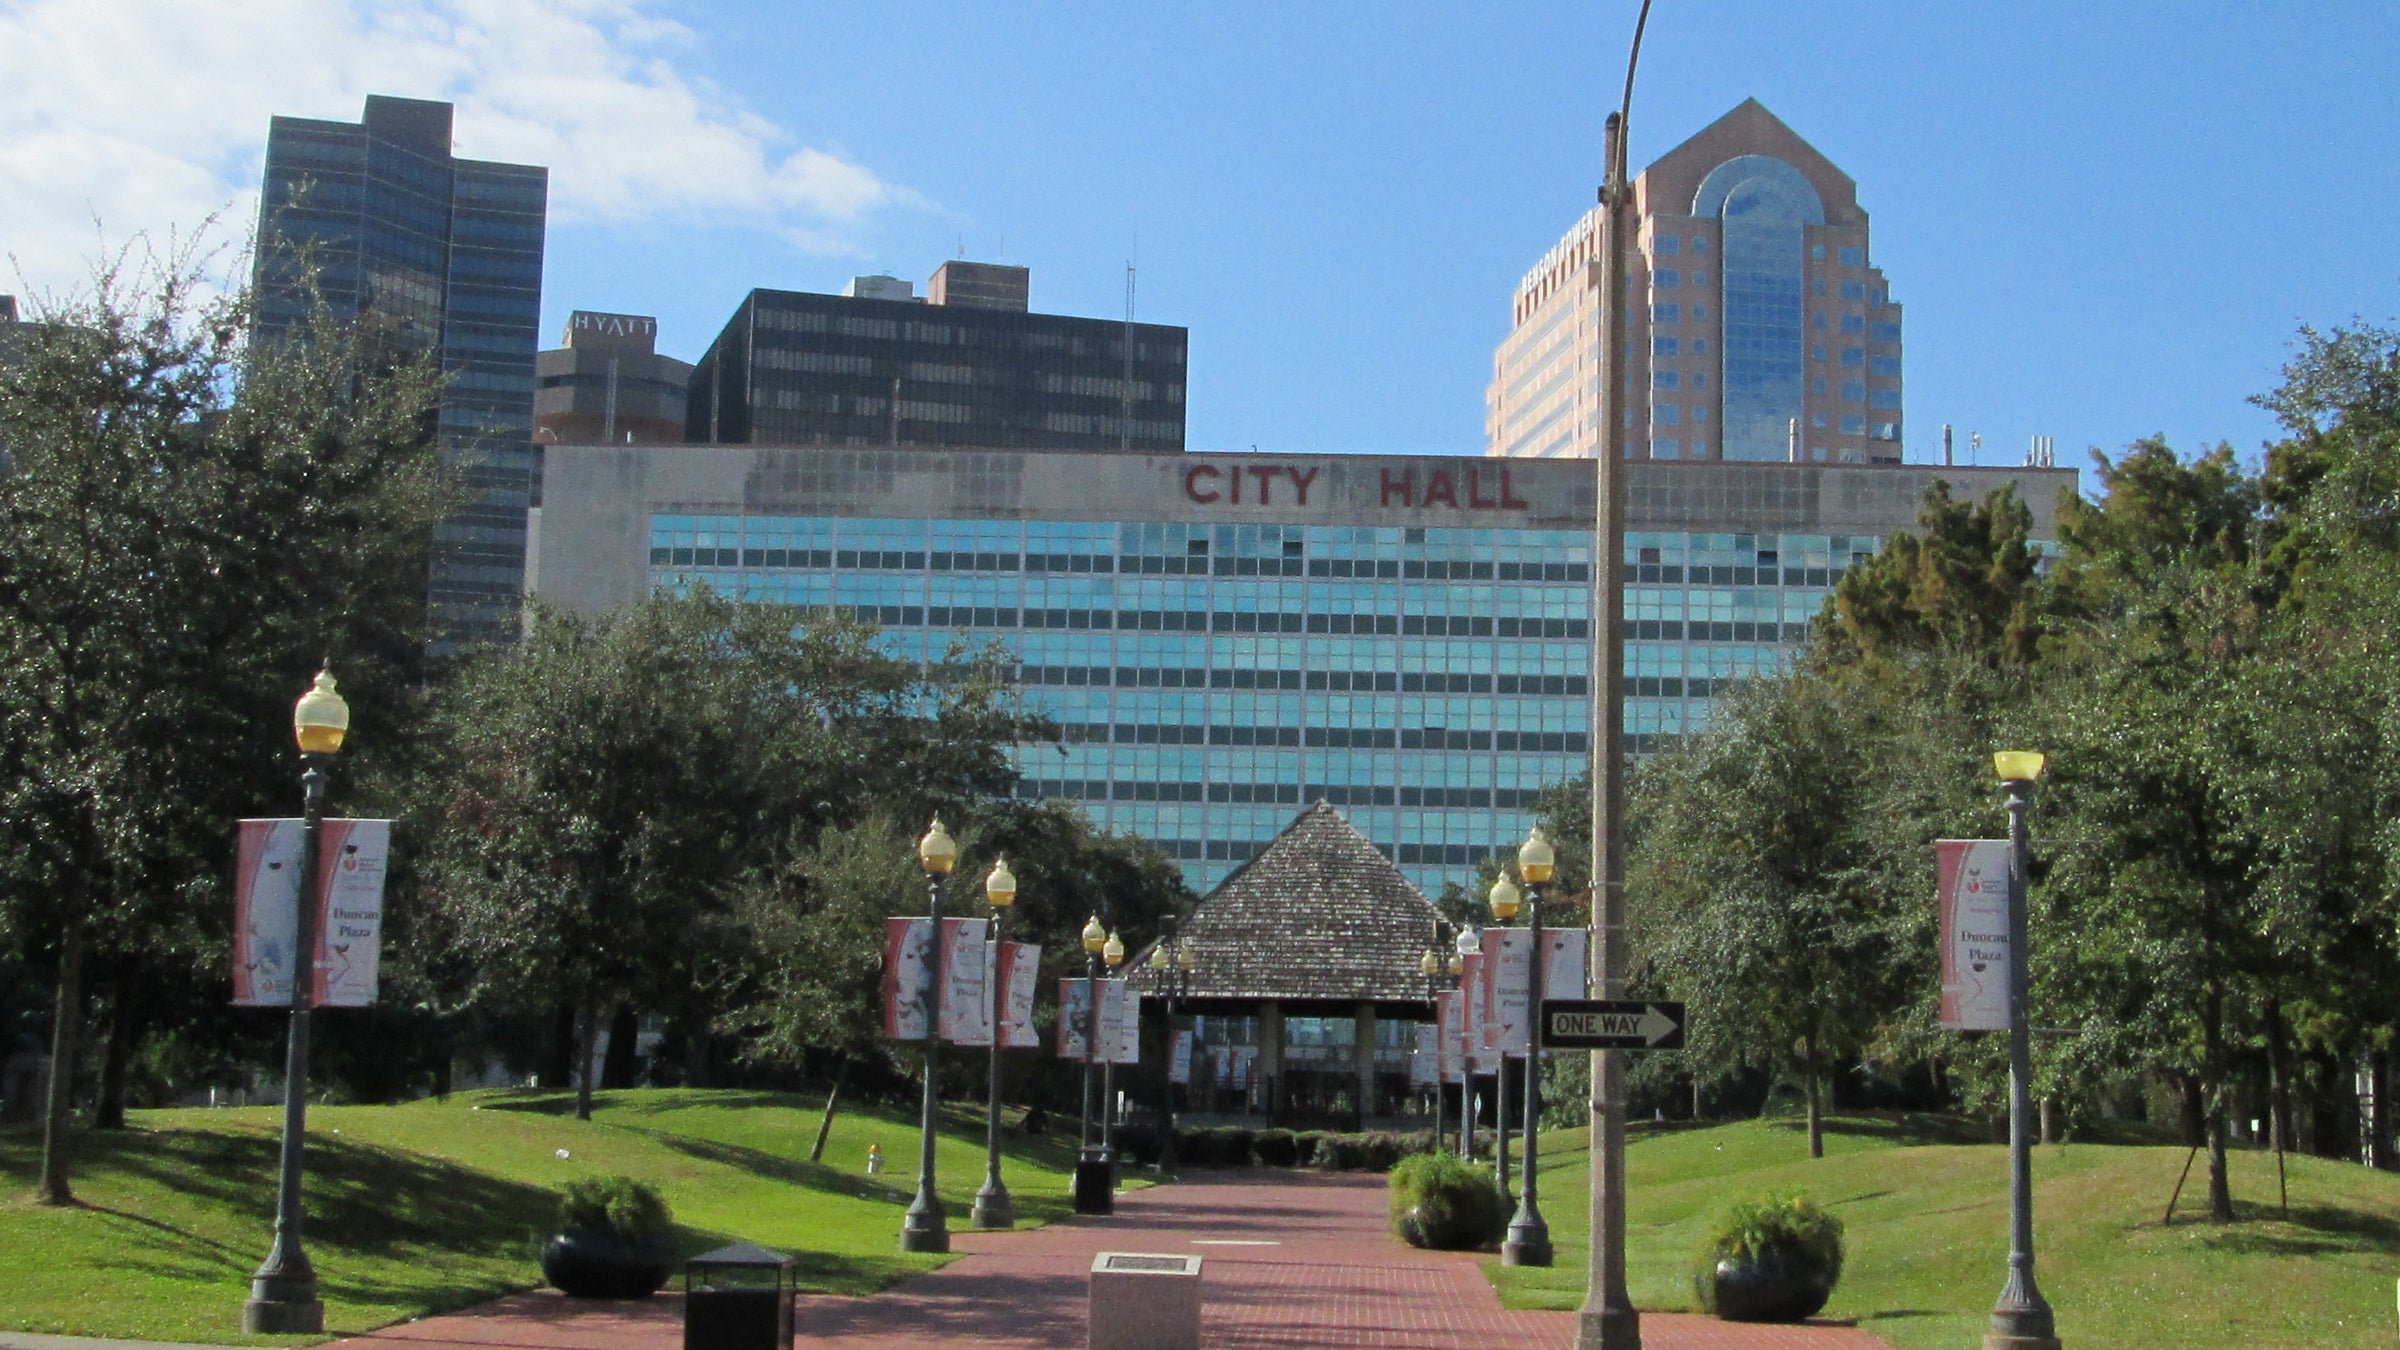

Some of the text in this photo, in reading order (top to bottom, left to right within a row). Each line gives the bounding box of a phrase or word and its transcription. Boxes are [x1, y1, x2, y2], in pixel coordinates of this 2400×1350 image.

[1559, 209, 1594, 258] TOWER
[575, 315, 654, 336] HYATT
[1184, 464, 1530, 511] CITY HALL
[332, 907, 380, 920] Duncan
[340, 926, 371, 937] Plaza
[1961, 931, 2009, 943] Duncan
[1969, 948, 2002, 960] Plaza
[1556, 1014, 1641, 1034] ONE WAY
